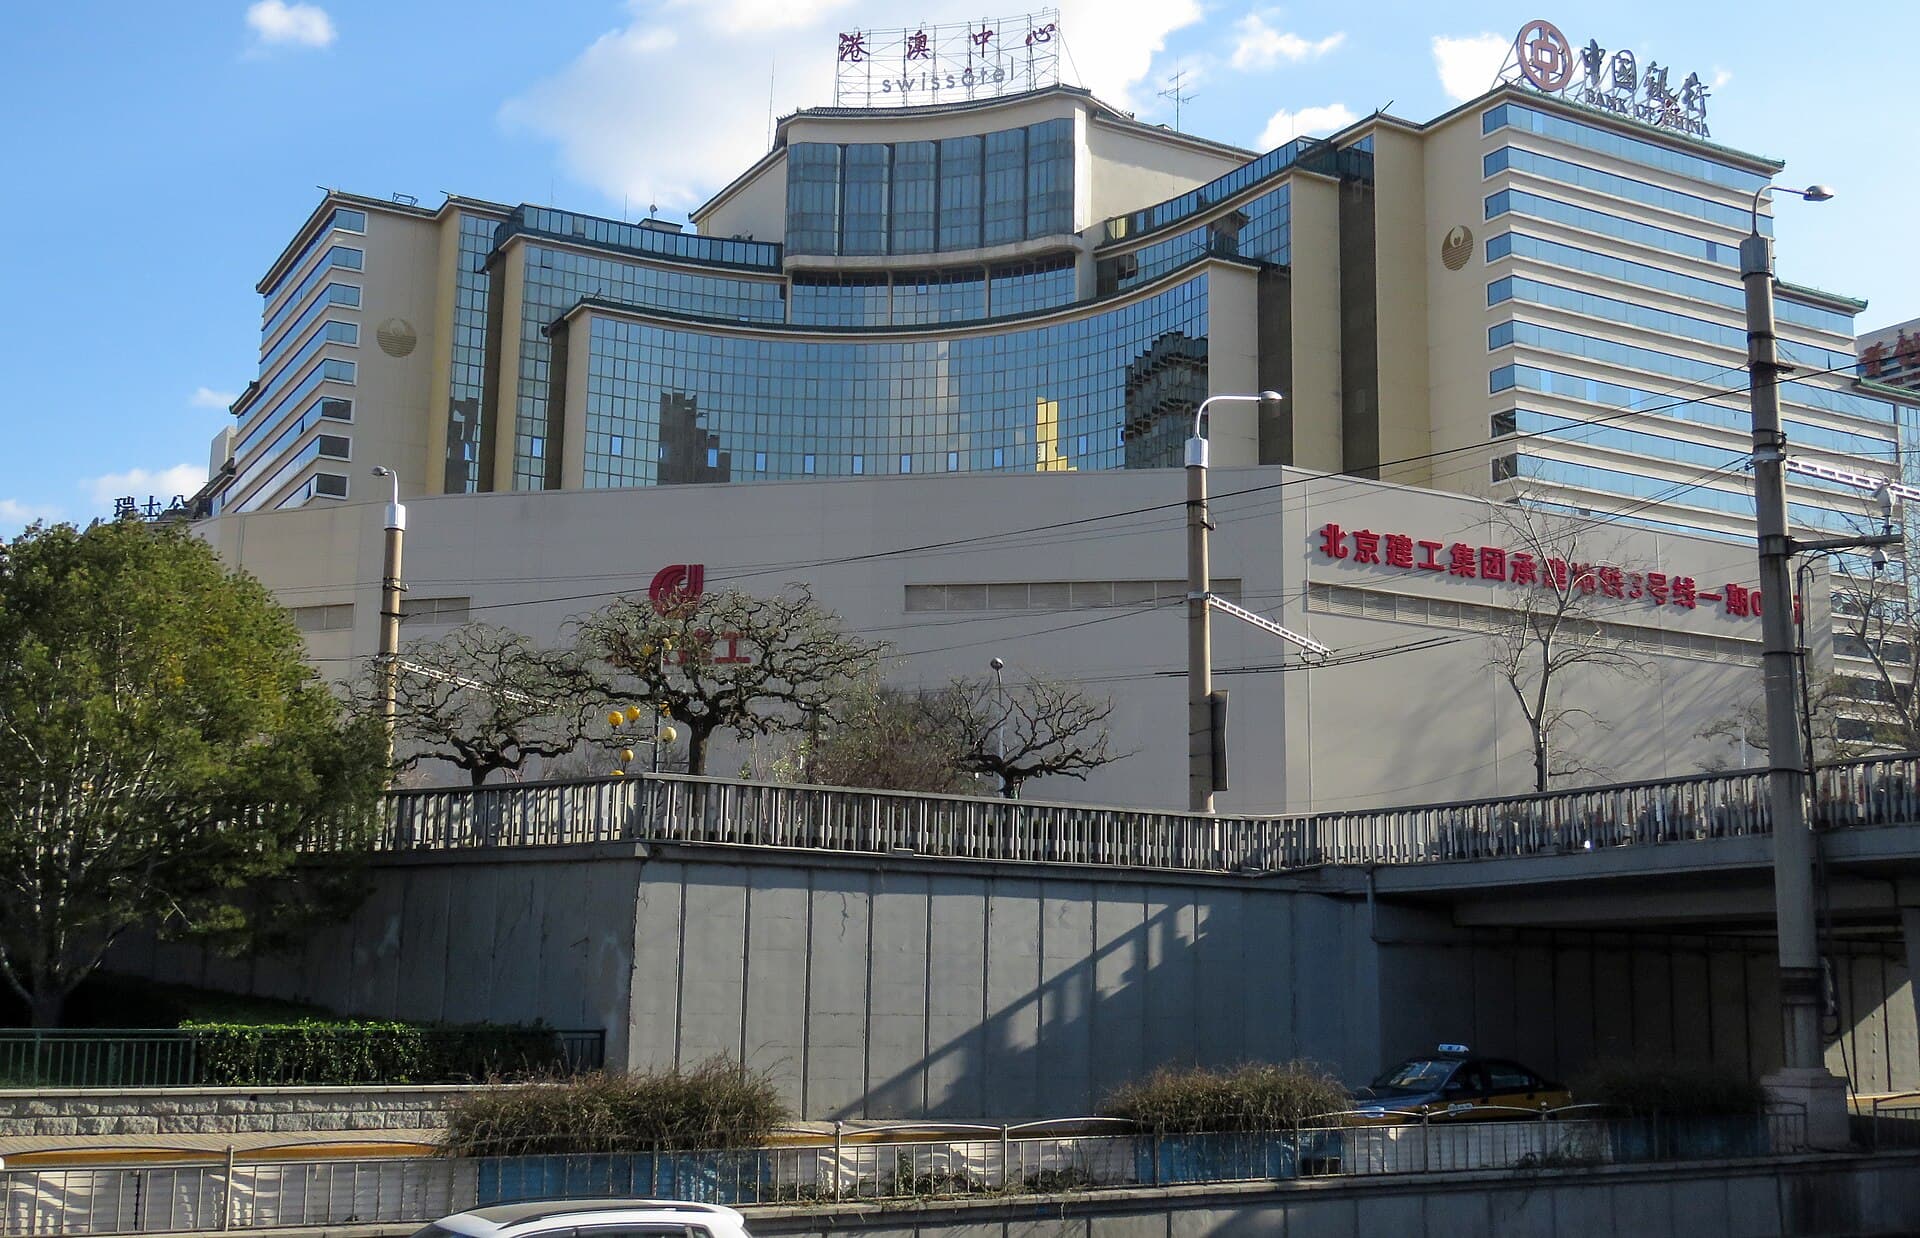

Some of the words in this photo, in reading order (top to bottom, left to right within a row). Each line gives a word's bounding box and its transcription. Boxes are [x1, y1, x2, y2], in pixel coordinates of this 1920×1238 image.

[839, 23, 1056, 62] 港澳中心
[1319, 522, 1803, 625] 北京建工集团承建地铁3号线一期0
